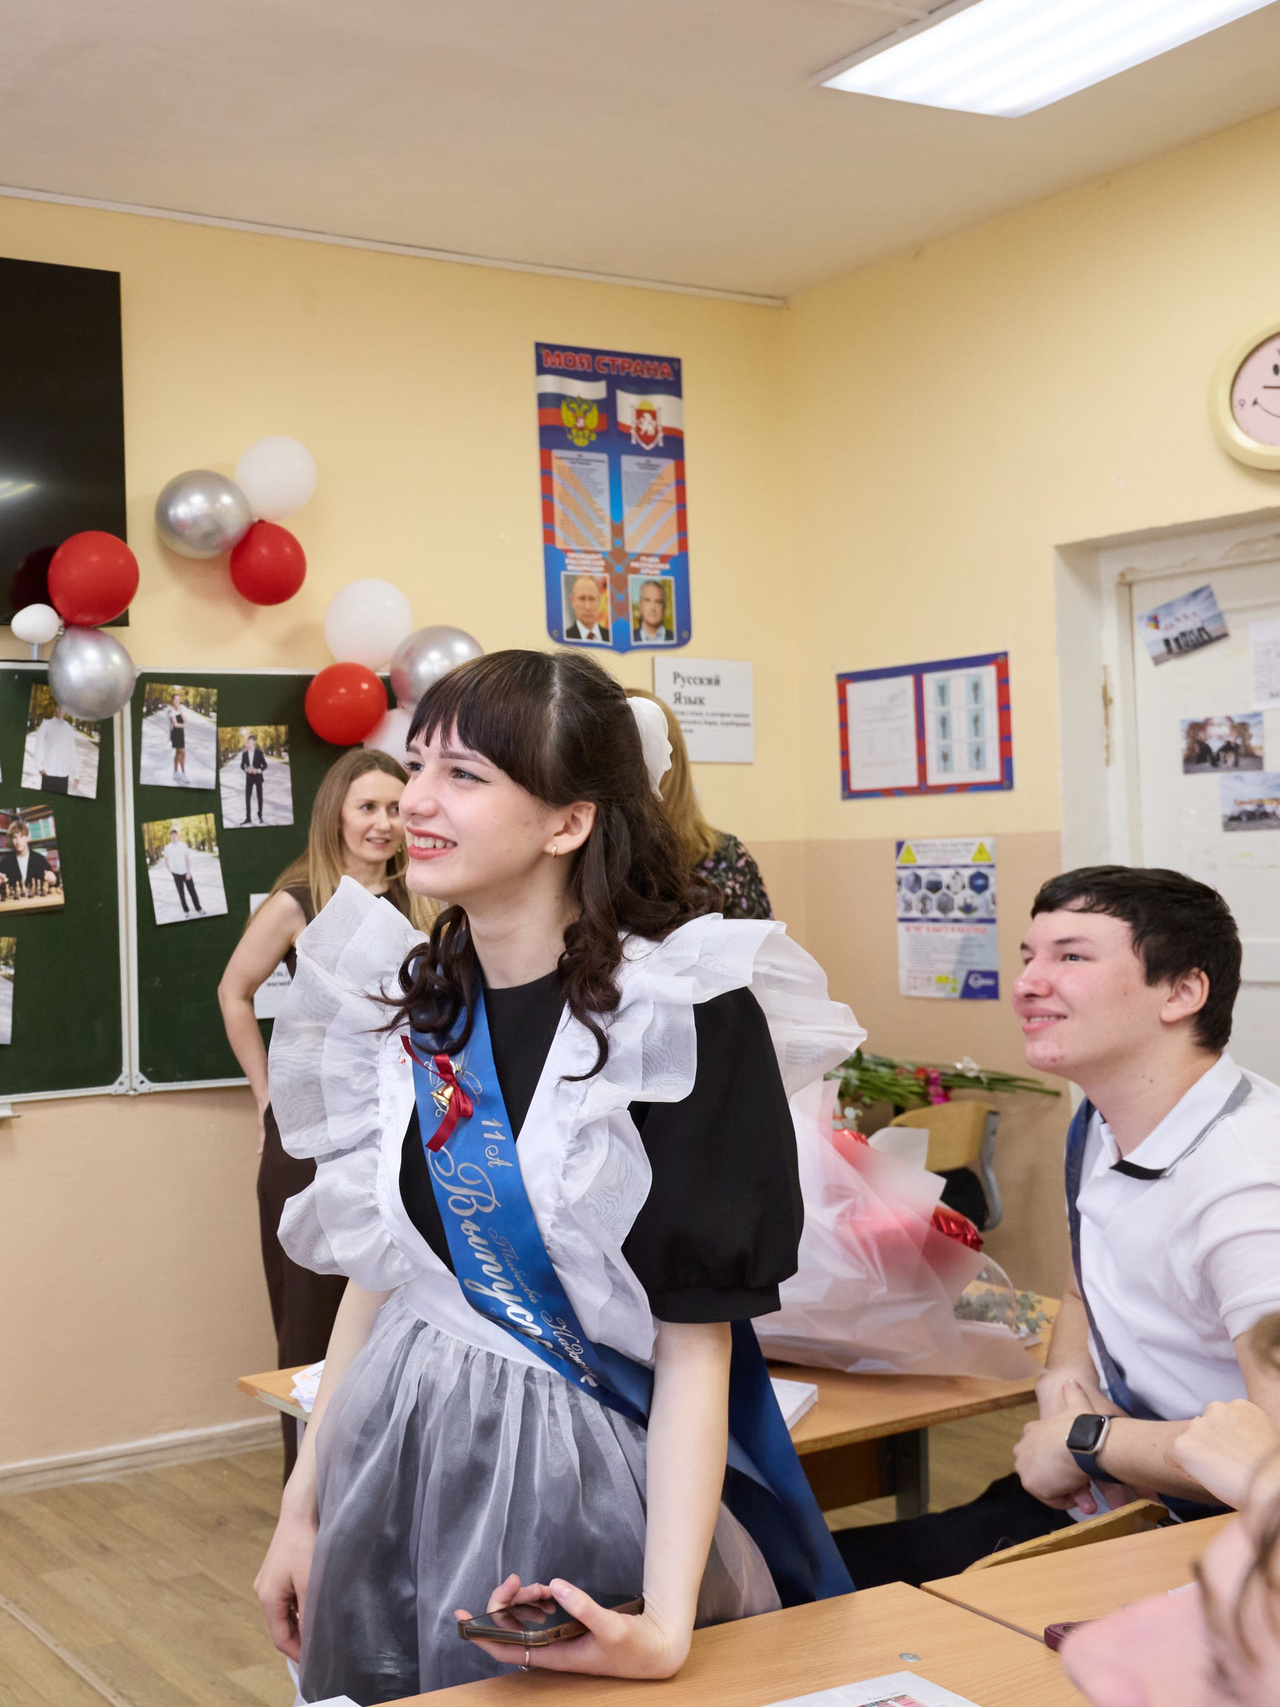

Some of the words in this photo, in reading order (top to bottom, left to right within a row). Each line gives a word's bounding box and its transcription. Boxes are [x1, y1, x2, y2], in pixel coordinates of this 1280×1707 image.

[542, 349, 593, 372] МОЯ
[594, 356, 675, 380] СТРАНА
[673, 671, 721, 688] Русский
[673, 692, 706, 706] Язык
